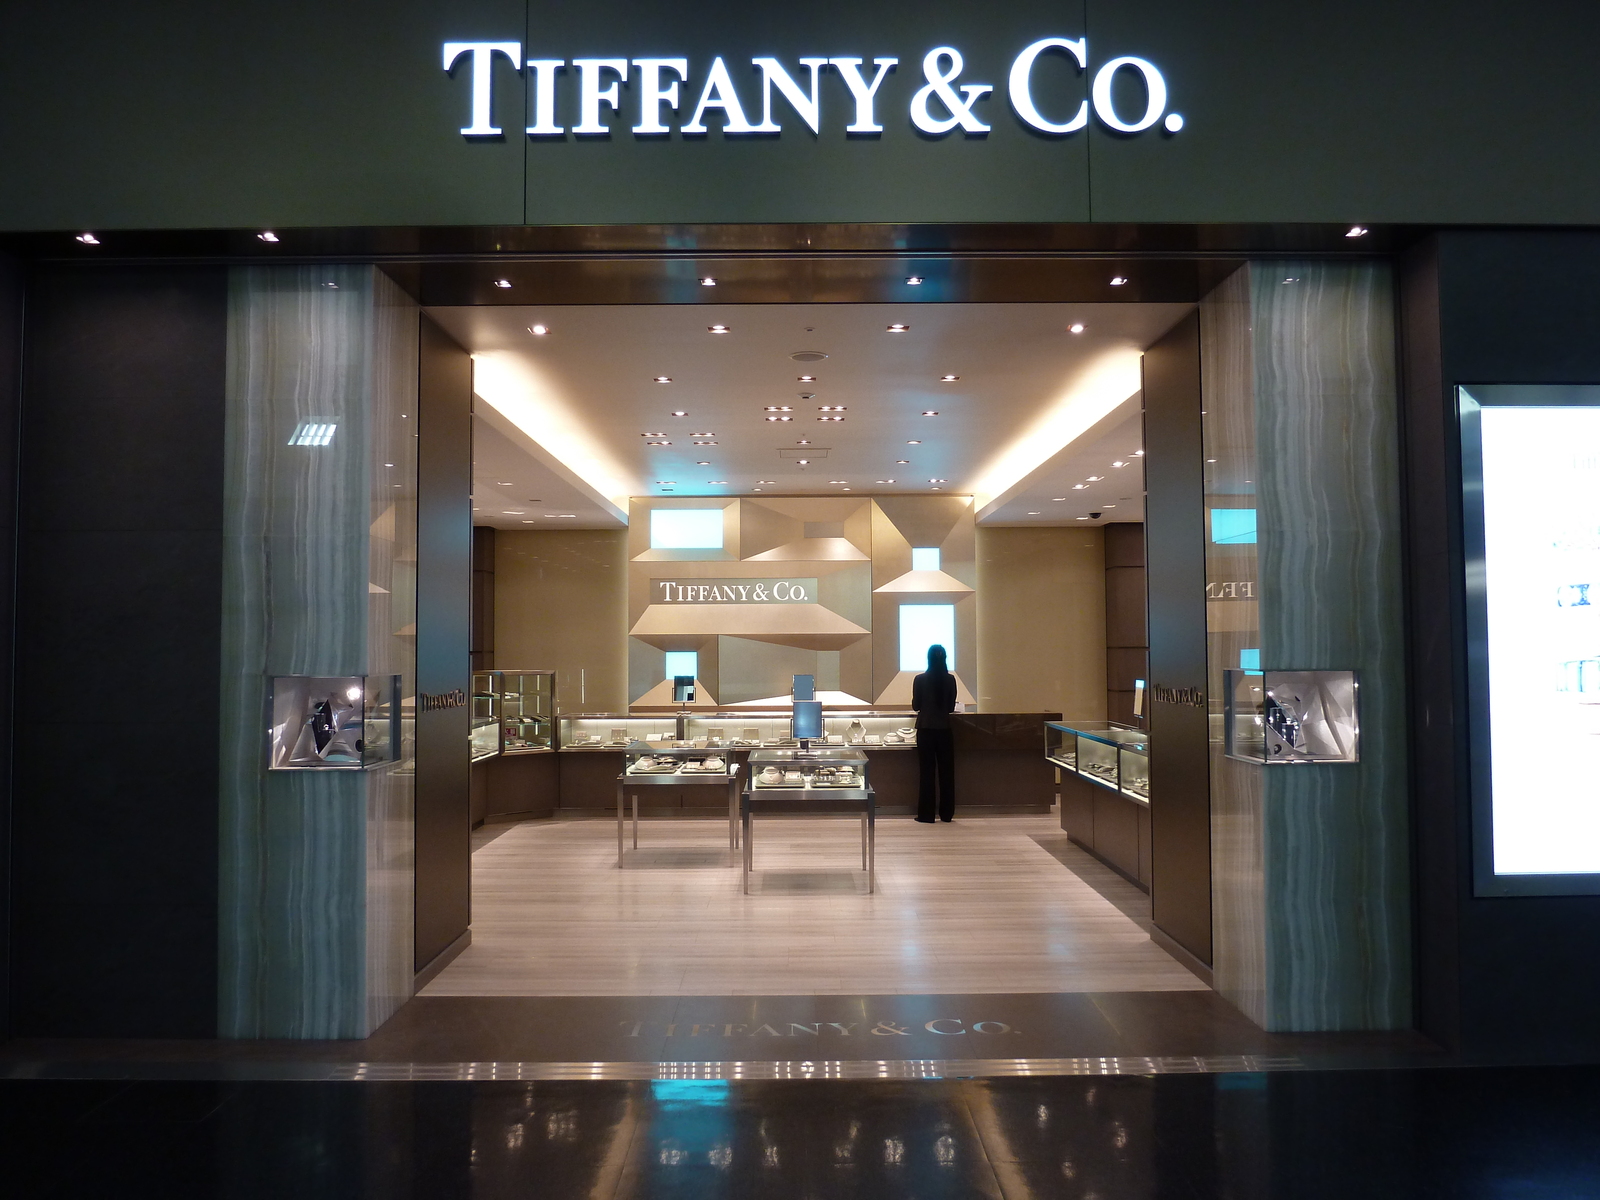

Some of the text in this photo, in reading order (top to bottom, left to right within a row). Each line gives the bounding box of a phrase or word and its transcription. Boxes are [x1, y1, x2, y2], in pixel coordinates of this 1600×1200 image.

[442, 41, 899, 137] TIFFANY
[909, 45, 994, 135] &
[659, 581, 751, 602] TIFFANY
[752, 582, 770, 602] &
[619, 1020, 859, 1037] TIFFANY
[870, 1020, 913, 1036] &
